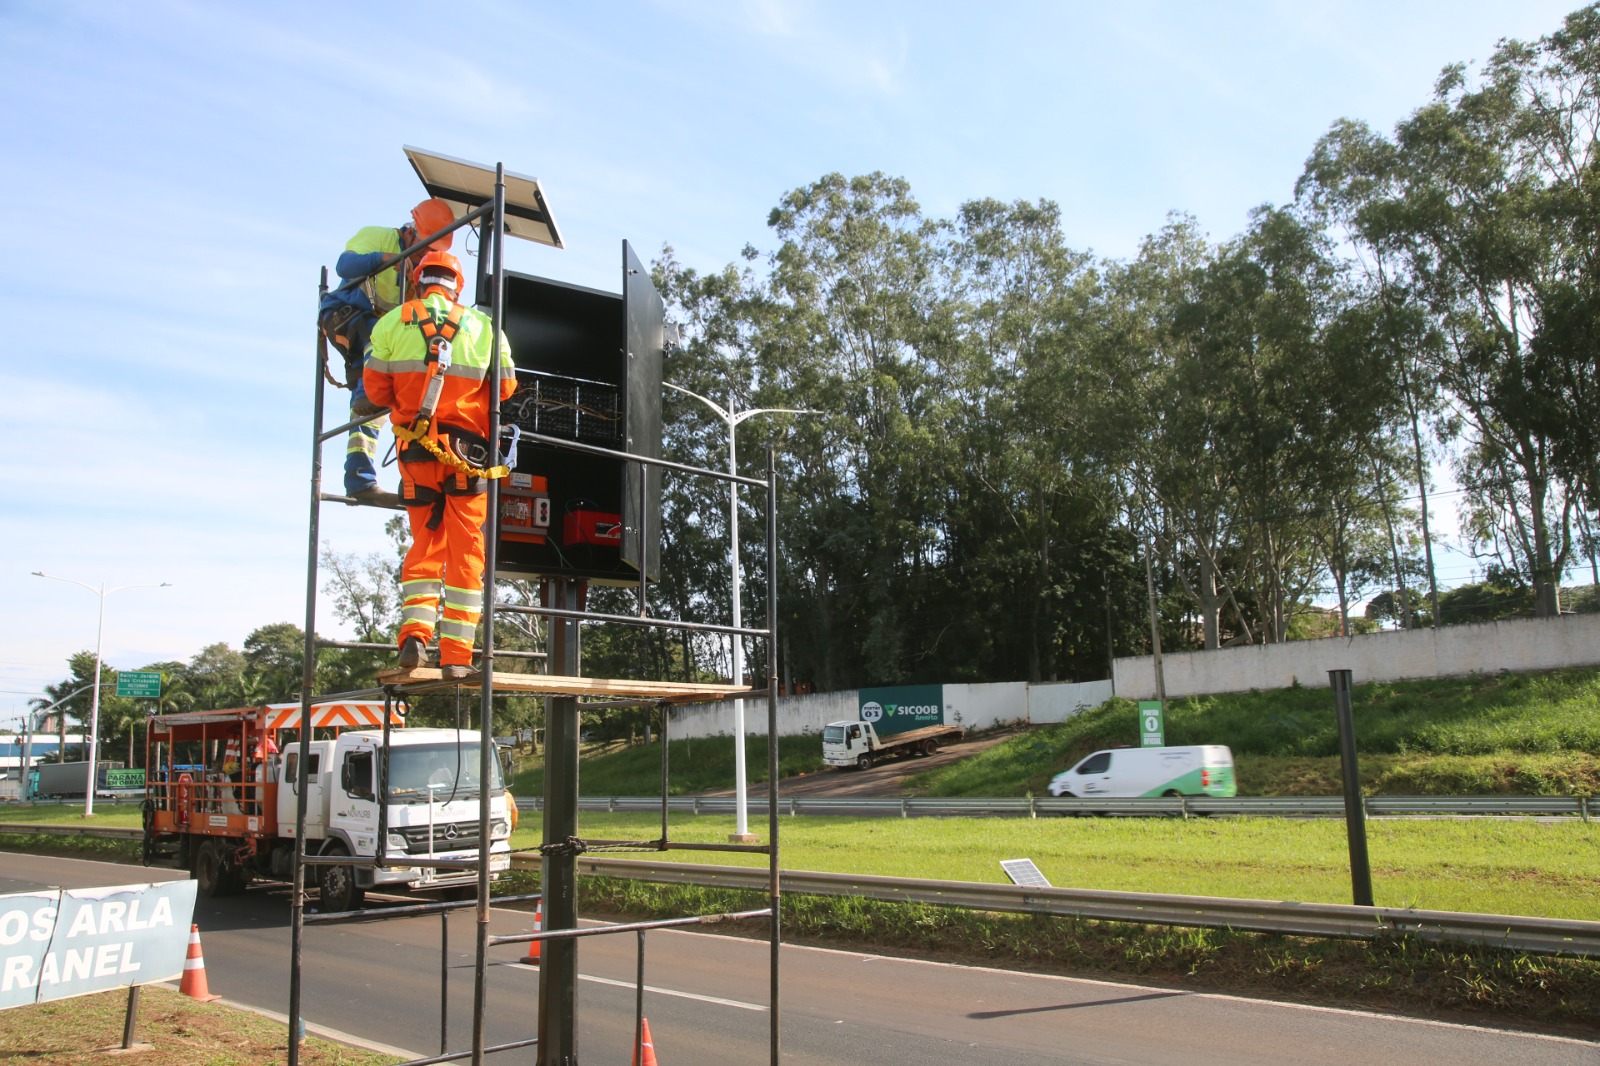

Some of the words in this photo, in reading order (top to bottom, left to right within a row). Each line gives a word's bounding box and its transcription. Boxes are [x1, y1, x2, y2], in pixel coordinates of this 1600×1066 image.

[897, 705, 938, 715] SICOOB
[1148, 719, 1154, 728] 1
[0, 907, 57, 945] OS
[66, 897, 174, 938] ARLA
[1, 941, 141, 992] RANEL
